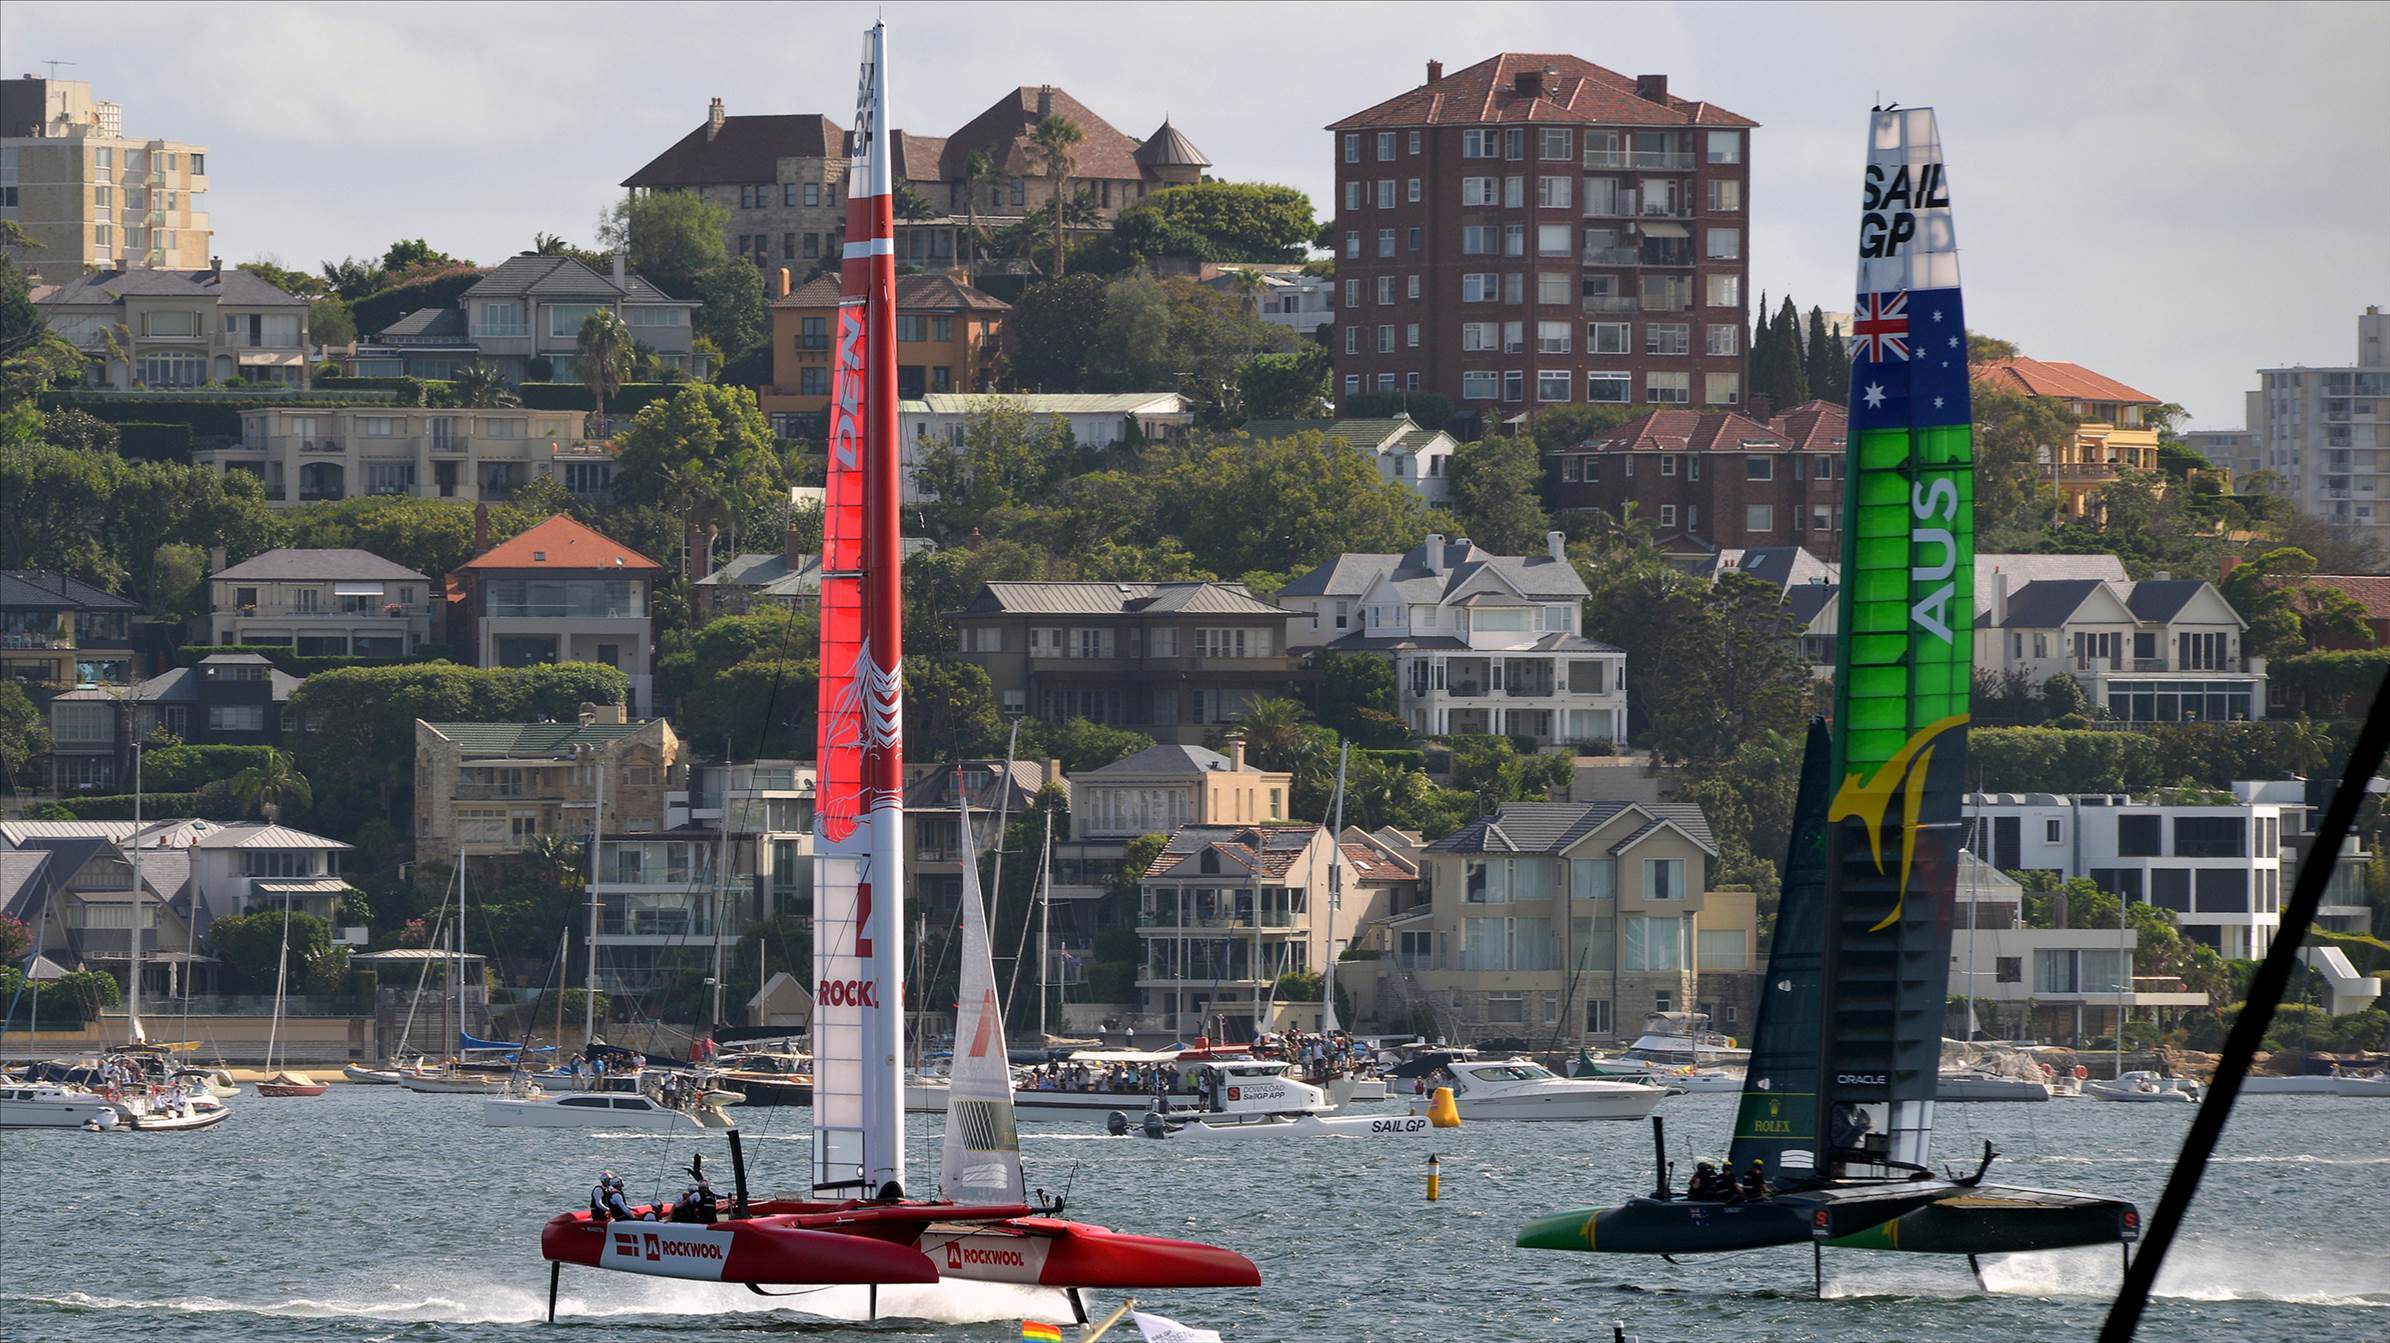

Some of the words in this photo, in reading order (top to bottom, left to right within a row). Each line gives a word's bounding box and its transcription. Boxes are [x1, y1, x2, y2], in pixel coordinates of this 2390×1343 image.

[1863, 163, 1950, 210] SAIL
[1859, 212, 1916, 258] GP
[836, 312, 861, 470] DEN
[1911, 477, 1958, 645] AUS
[819, 980, 879, 1008] ROCK
[1243, 1085, 1286, 1093] DOWNLOAD
[1837, 1075, 1887, 1084] ORACLE
[1371, 1120, 1404, 1133] SAIL
[1405, 1120, 1426, 1132] GP
[1754, 1120, 1791, 1132] ROLEX
[662, 1240, 723, 1259] ROCKWOOL
[963, 1249, 1024, 1266] ROCKWOOL
